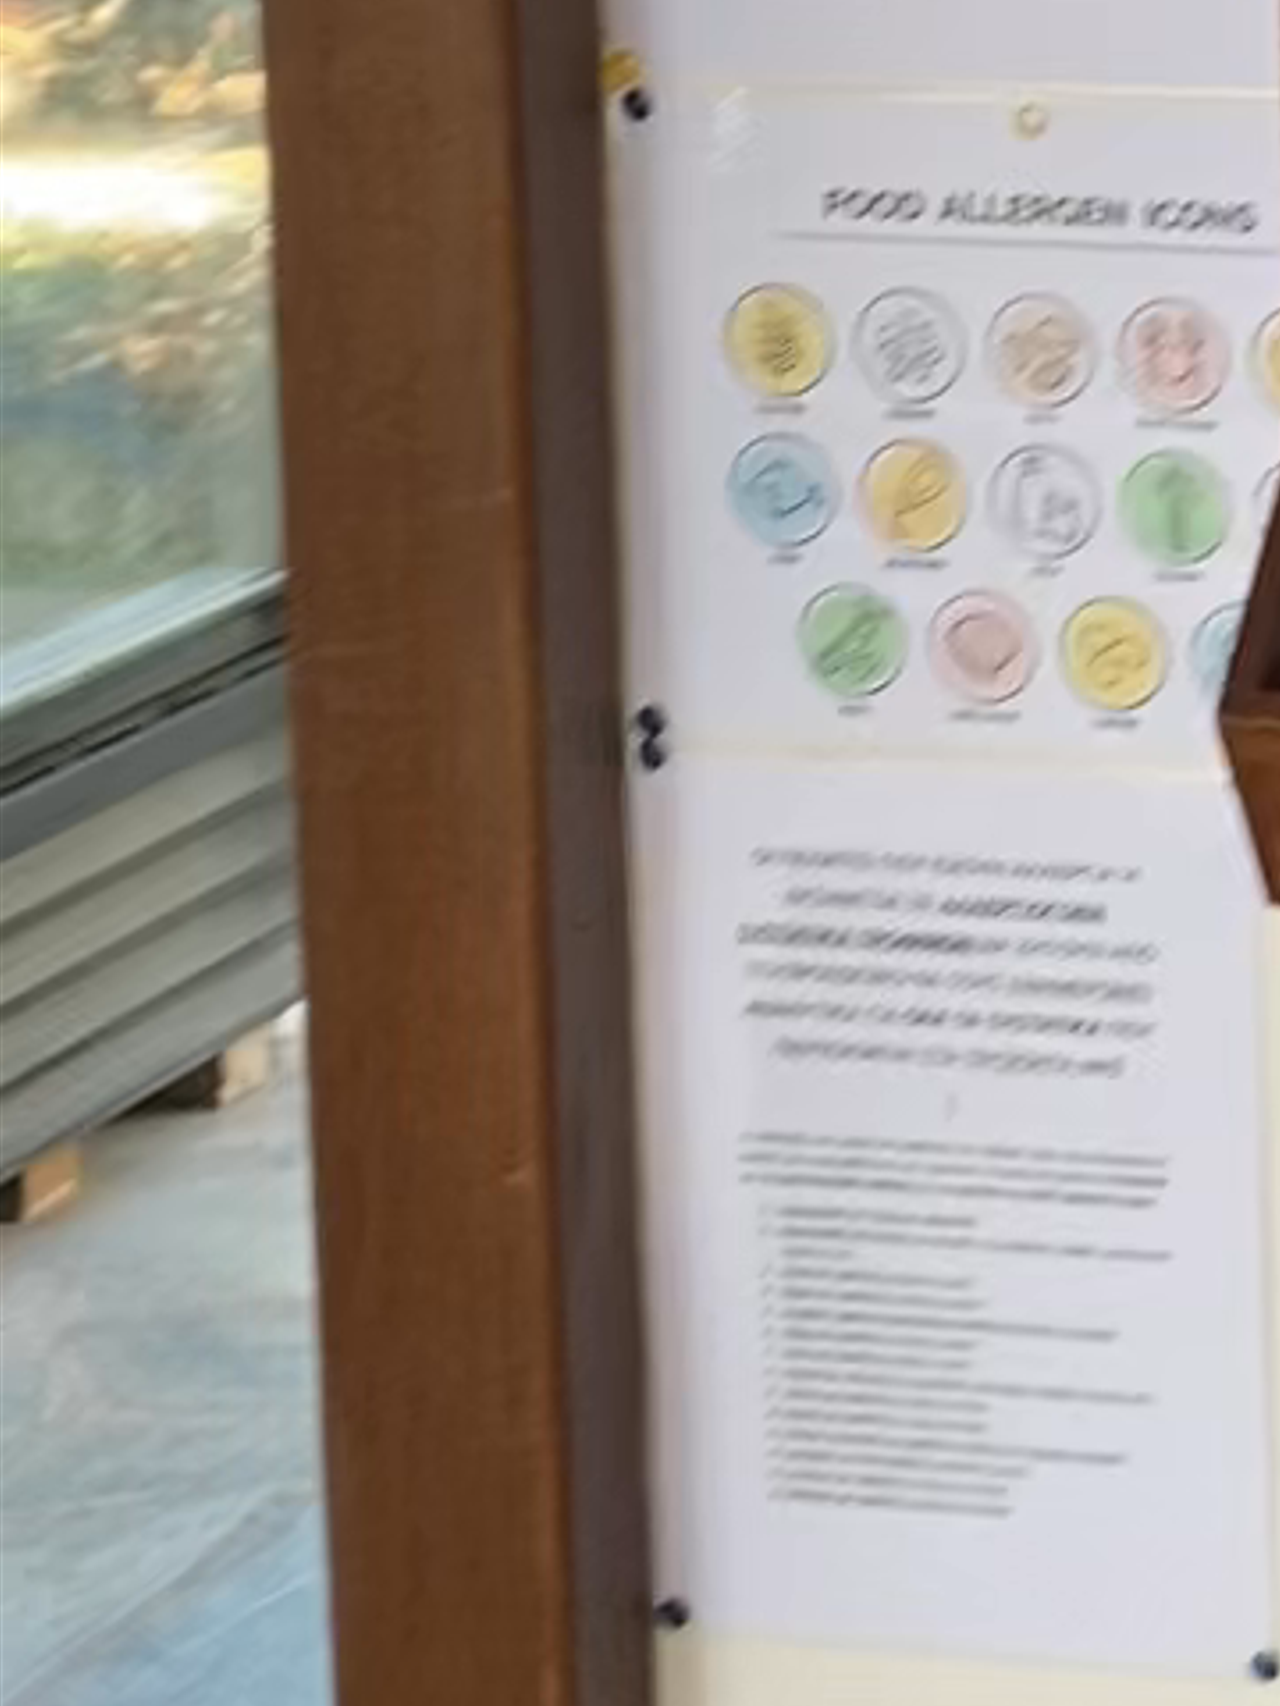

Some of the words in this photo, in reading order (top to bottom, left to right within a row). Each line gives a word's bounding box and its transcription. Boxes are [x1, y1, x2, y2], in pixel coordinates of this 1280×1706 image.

[821, 188, 927, 223] FOOD
[935, 191, 1130, 228] ALLERGEN
[1142, 197, 1260, 235] ICONS
